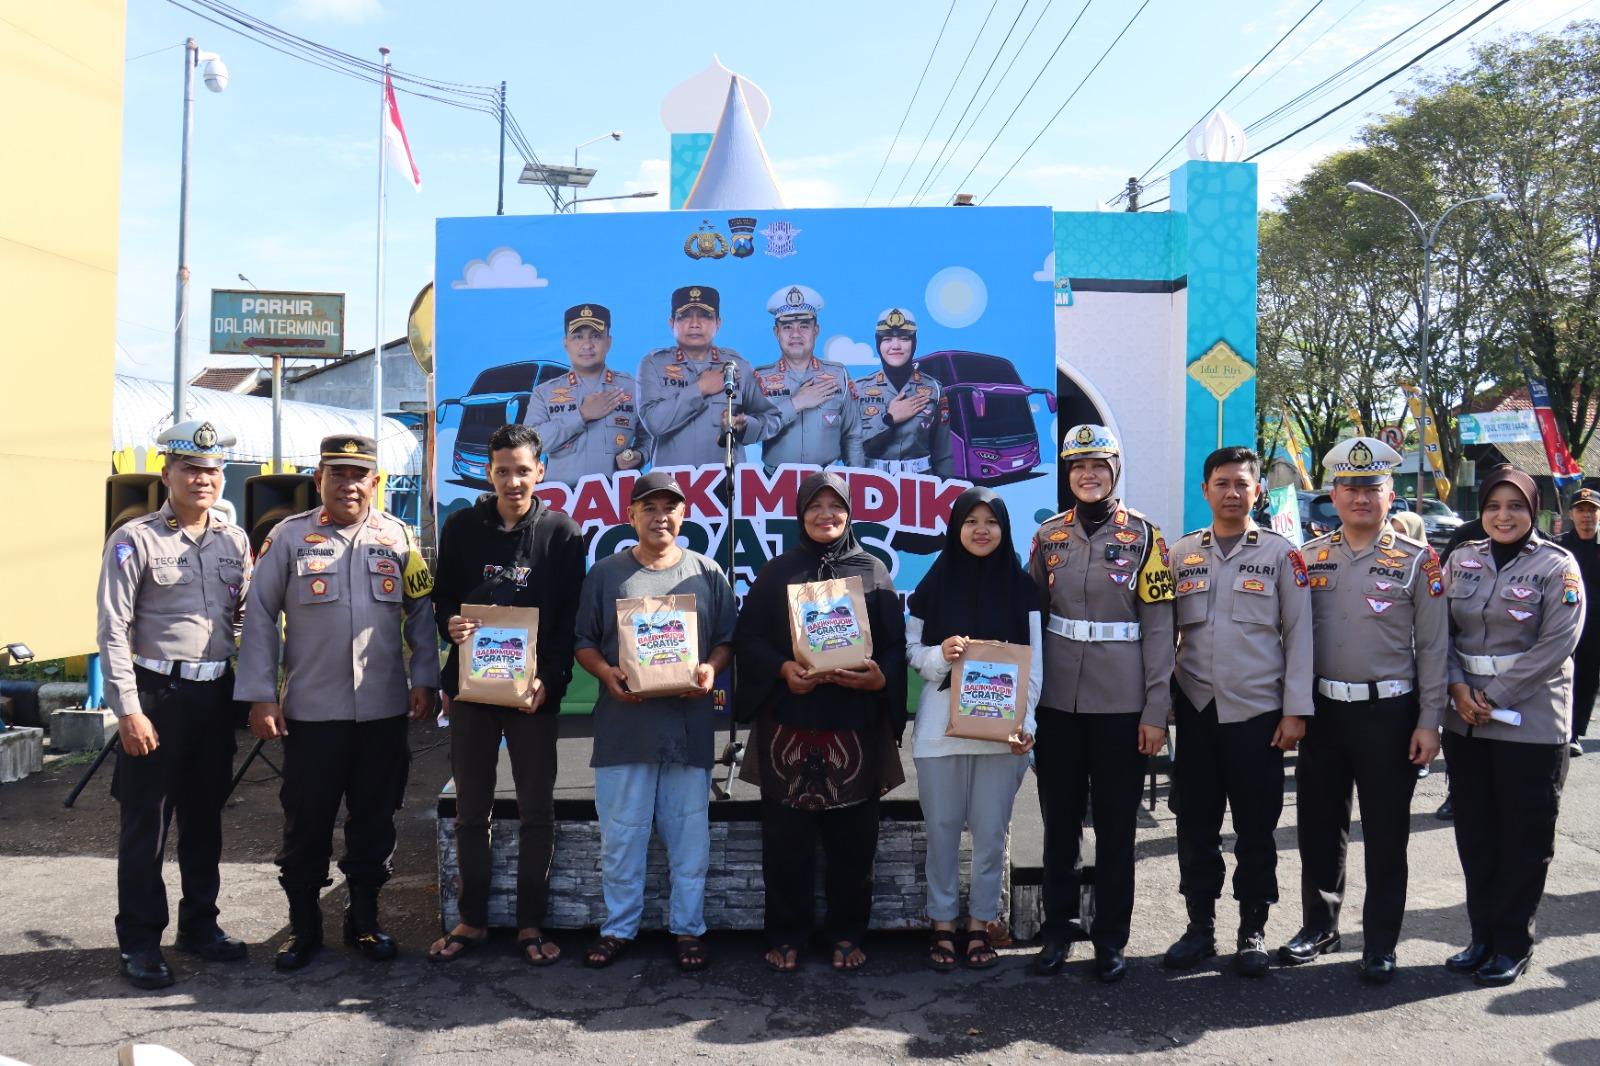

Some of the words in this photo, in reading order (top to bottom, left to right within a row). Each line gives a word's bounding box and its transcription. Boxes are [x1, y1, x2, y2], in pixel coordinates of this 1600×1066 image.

[241, 298, 313, 315] PARKIR
[214, 317, 265, 334] DALAM
[267, 319, 340, 337] TERMINAL
[533, 470, 723, 527] BALK
[741, 468, 968, 530] MDIK
[1178, 567, 1209, 579] NOVAN
[1239, 564, 1275, 575] POLRI
[1369, 566, 1405, 580] POLRI
[816, 624, 848, 636] GRATIS
[647, 639, 680, 650] GRATIS
[483, 655, 515, 664] GRATIS
[971, 690, 1005, 702] GRATIS
